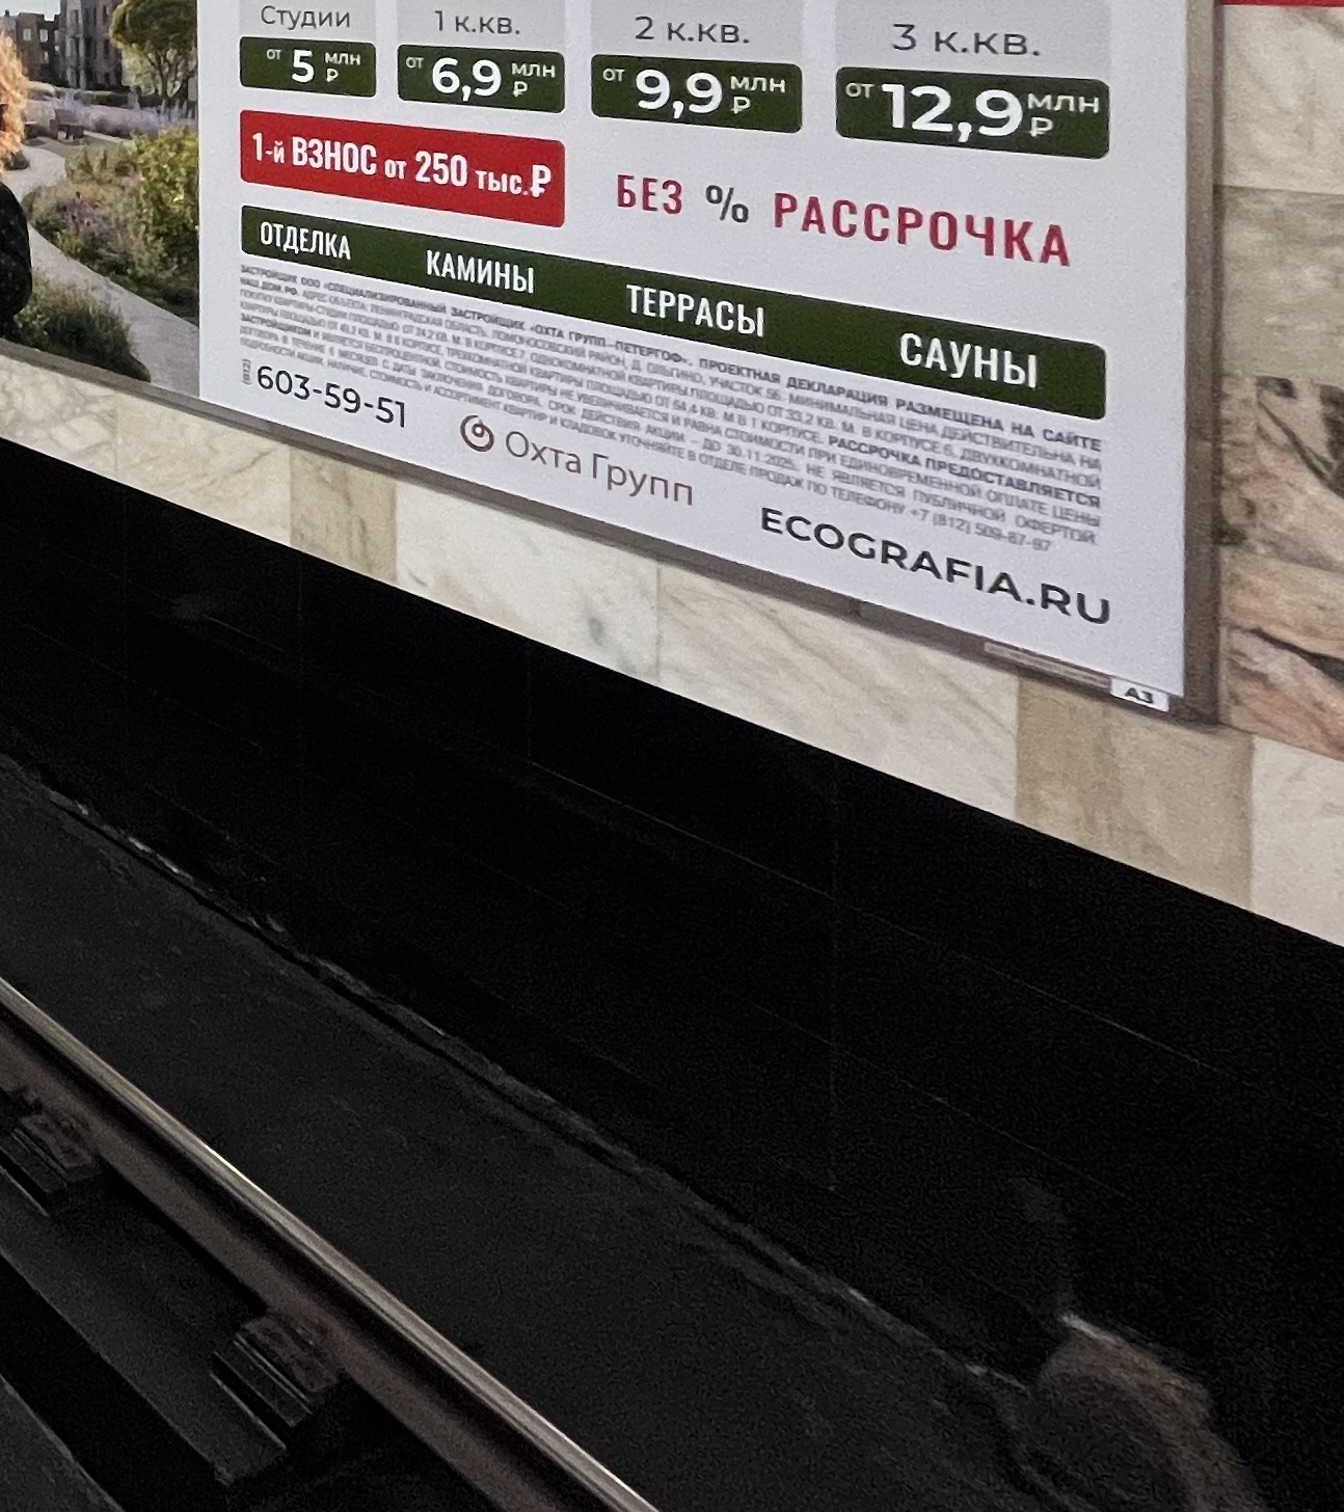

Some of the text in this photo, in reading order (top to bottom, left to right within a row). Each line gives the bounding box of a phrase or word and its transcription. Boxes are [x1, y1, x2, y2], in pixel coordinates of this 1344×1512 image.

[261, 5, 351, 30] Студии
[436, 11, 444, 30] 1
[635, 16, 654, 39] 2
[892, 24, 916, 50] 3
[267, 49, 361, 83] от 5 млн
[406, 57, 556, 101] от 6,9 млн
[603, 69, 785, 119] от 9,9 млн
[845, 82, 1099, 142] от 12,9 млн
[252, 133, 284, 164] 1-й
[292, 137, 377, 175] ВЗНОС
[385, 159, 406, 179] от
[415, 151, 468, 187] 250
[617, 174, 1070, 267] БЕЗ % РАССРОЧКА
[261, 221, 1038, 388] ОТДЕЛКА КАМИНЫ ТЕРРАСЫ САУНЫ
[257, 366, 405, 428] 603-59-51
[506, 431, 694, 506] Охта Групп
[827, 434, 1100, 509] РАССРОЧКА ПРЕДОСТАВЛЯЕТСЯ
[761, 507, 1111, 624] ECOGRAFIA.RU
